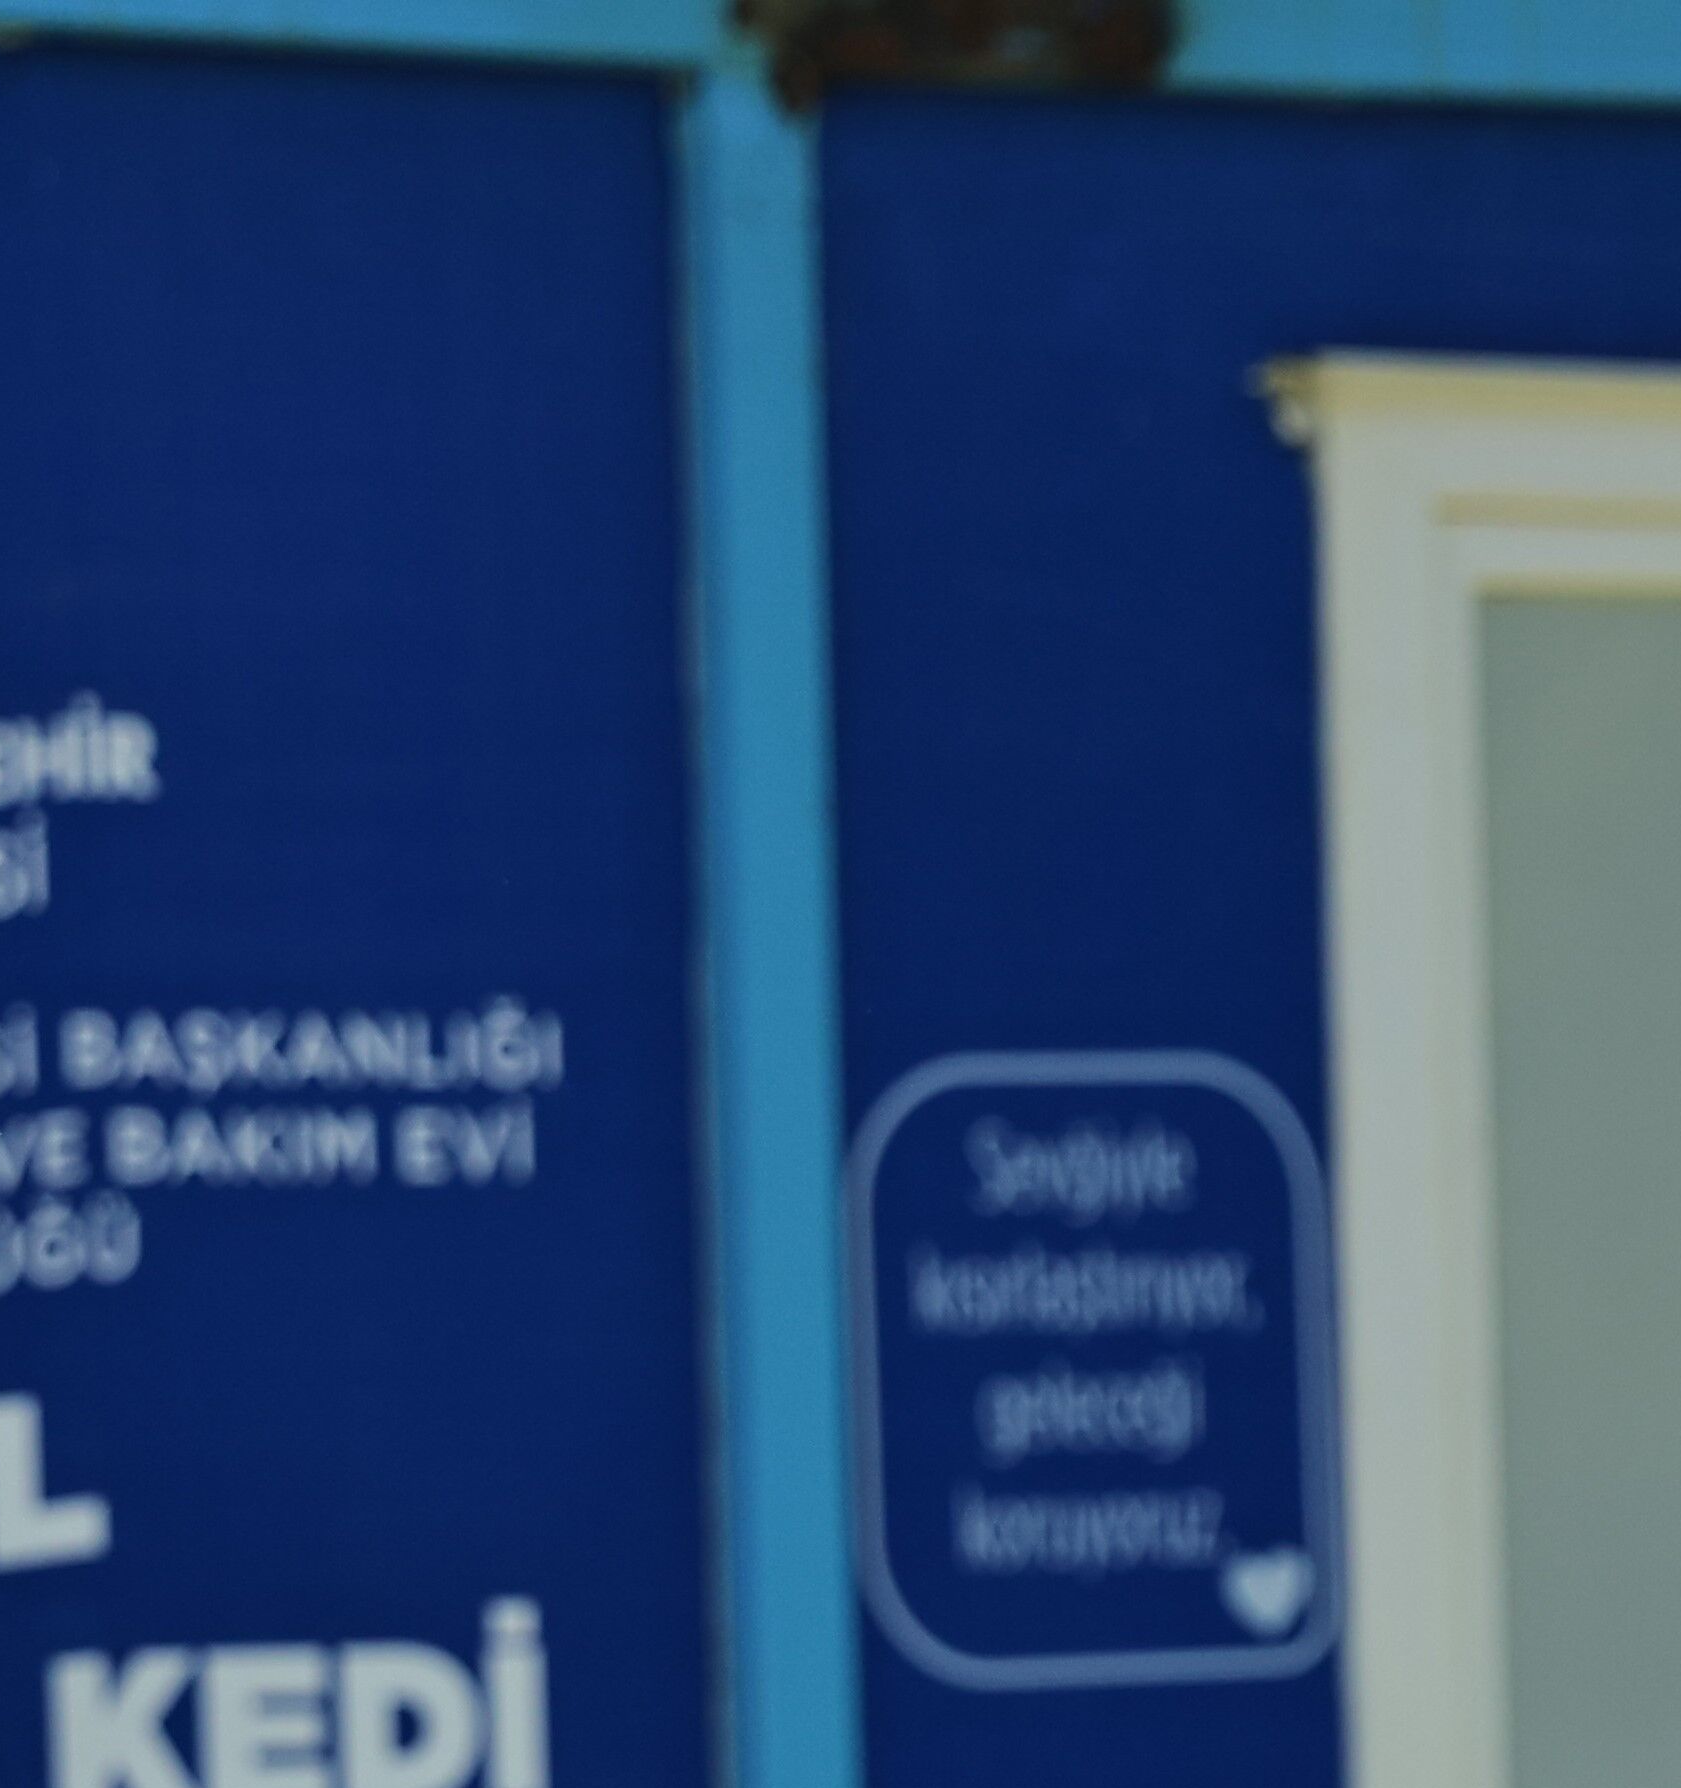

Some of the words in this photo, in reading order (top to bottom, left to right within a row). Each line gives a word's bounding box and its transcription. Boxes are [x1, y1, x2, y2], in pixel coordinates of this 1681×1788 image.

[61, 998, 563, 1097] BAŞKANLIĞI
[107, 1105, 378, 1187] BAKIM
[395, 1098, 534, 1186] EVİ
